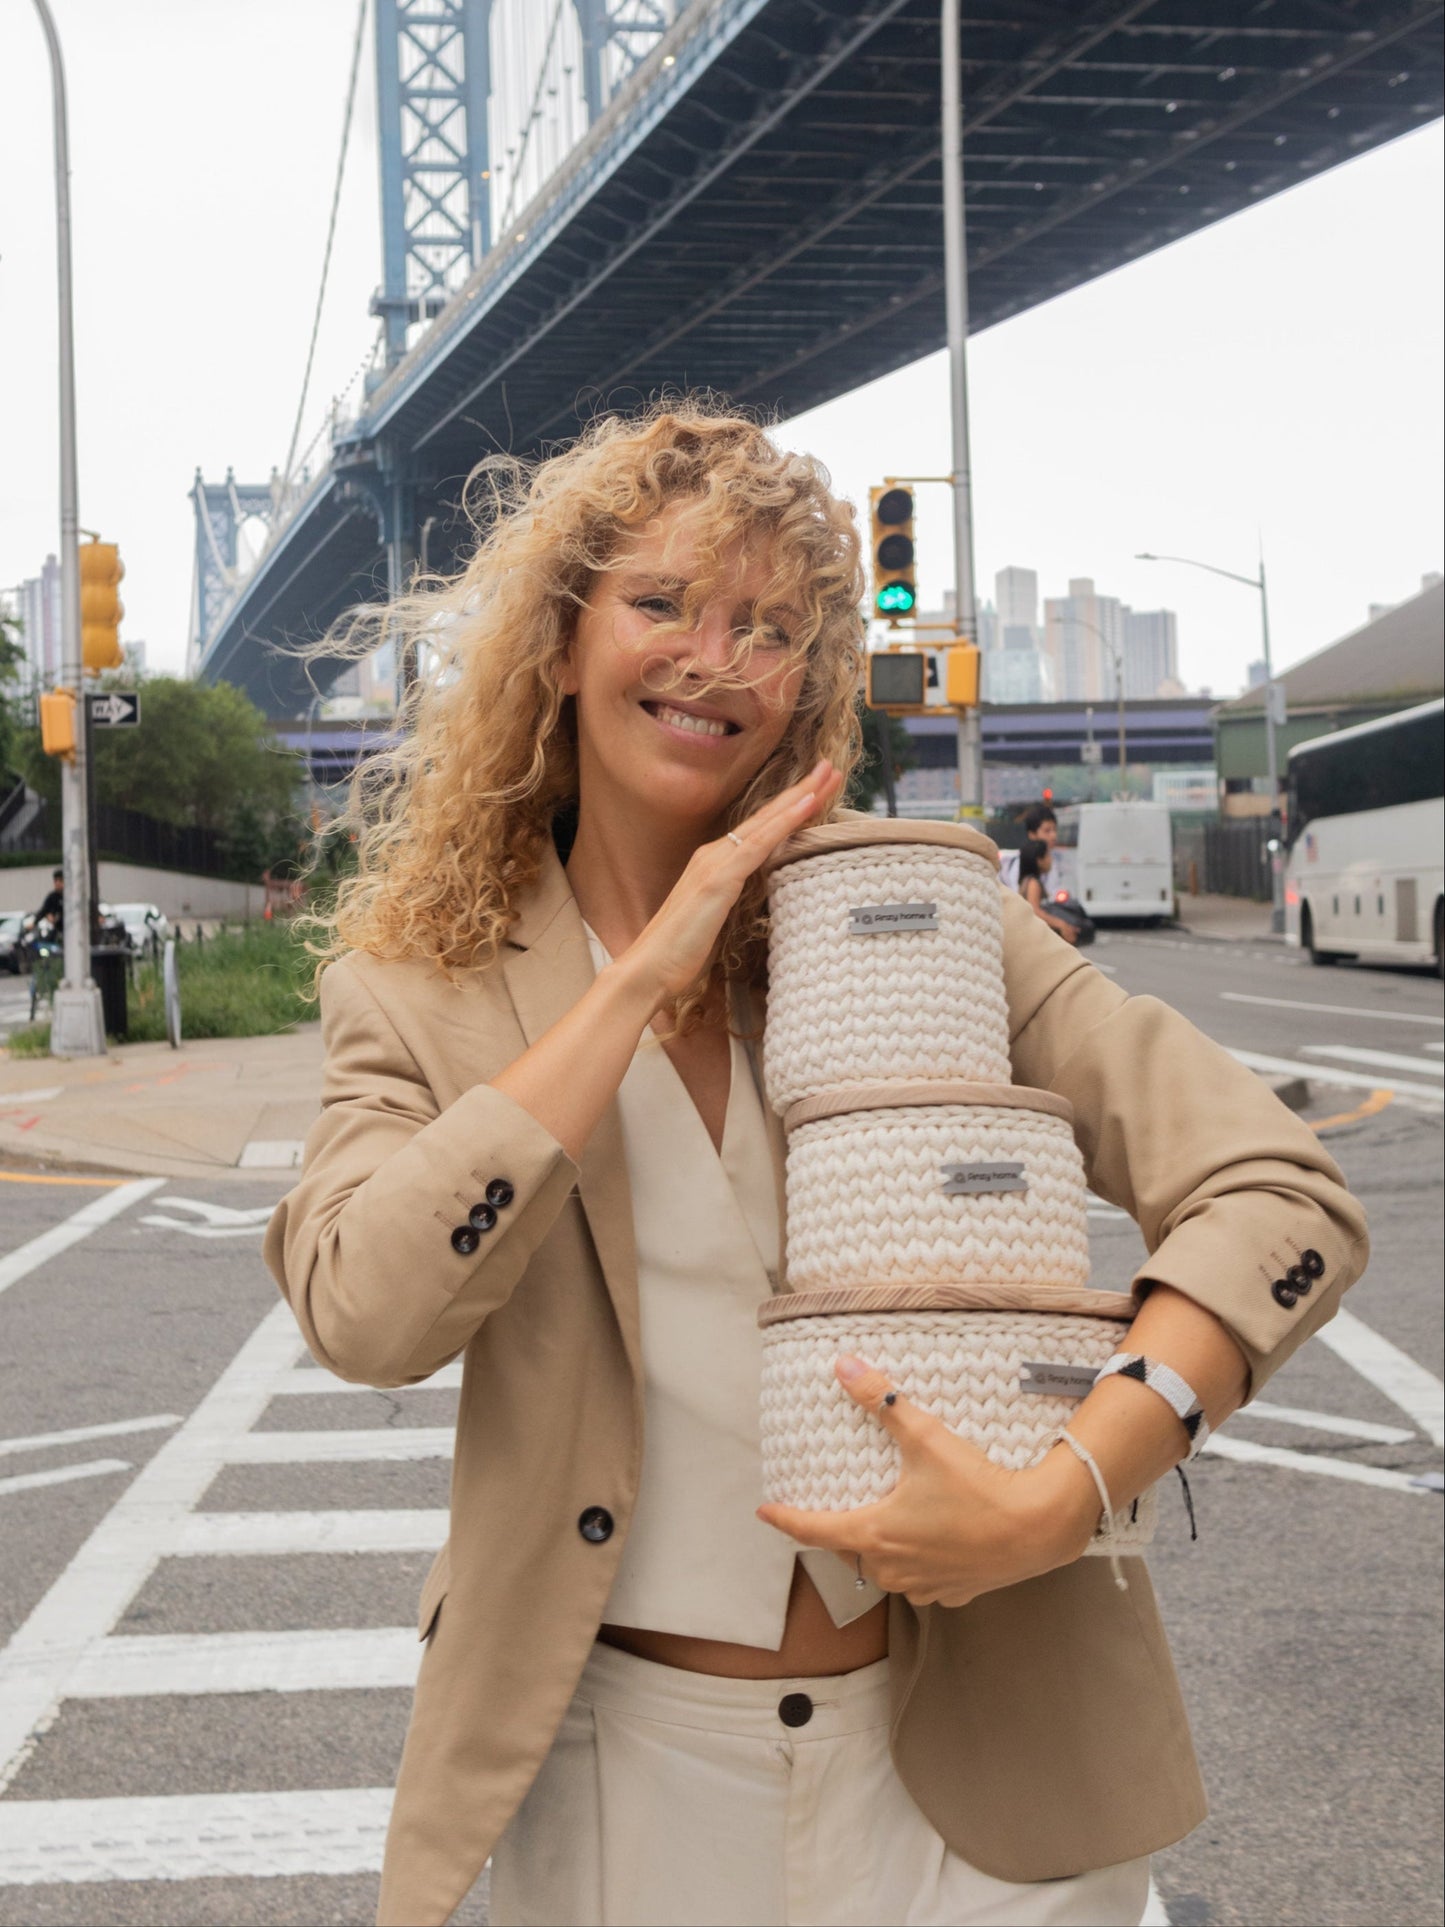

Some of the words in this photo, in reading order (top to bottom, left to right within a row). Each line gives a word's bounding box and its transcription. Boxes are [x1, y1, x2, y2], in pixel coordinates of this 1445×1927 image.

[95, 703, 121, 715] WAY
[900, 912, 926, 920] home
[992, 1171, 1018, 1179] home
